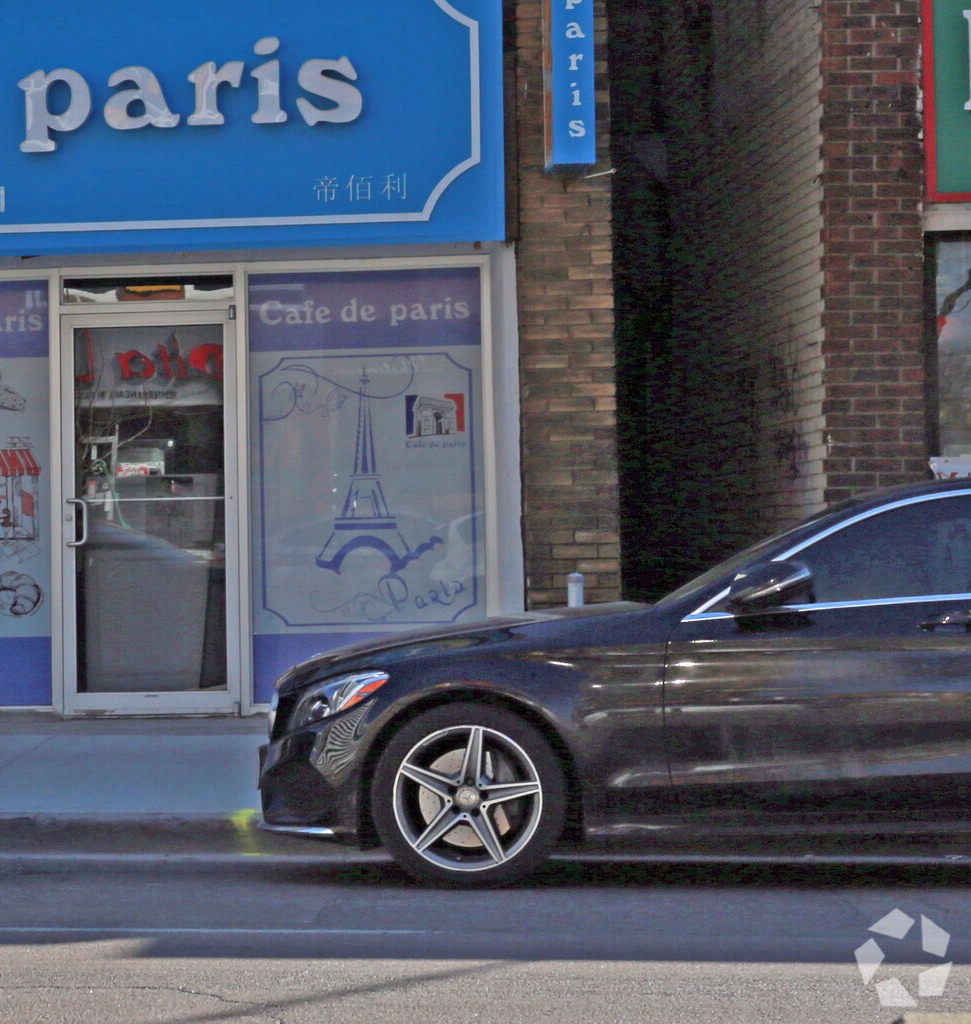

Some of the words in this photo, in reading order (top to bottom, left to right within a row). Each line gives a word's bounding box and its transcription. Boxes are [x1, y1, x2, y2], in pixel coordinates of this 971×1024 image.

[18, 35, 363, 153] paris
[312, 172, 409, 204] 帝佰利
[259, 300, 331, 325] Cafe
[340, 298, 376, 322] de
[389, 297, 470, 326] paris
